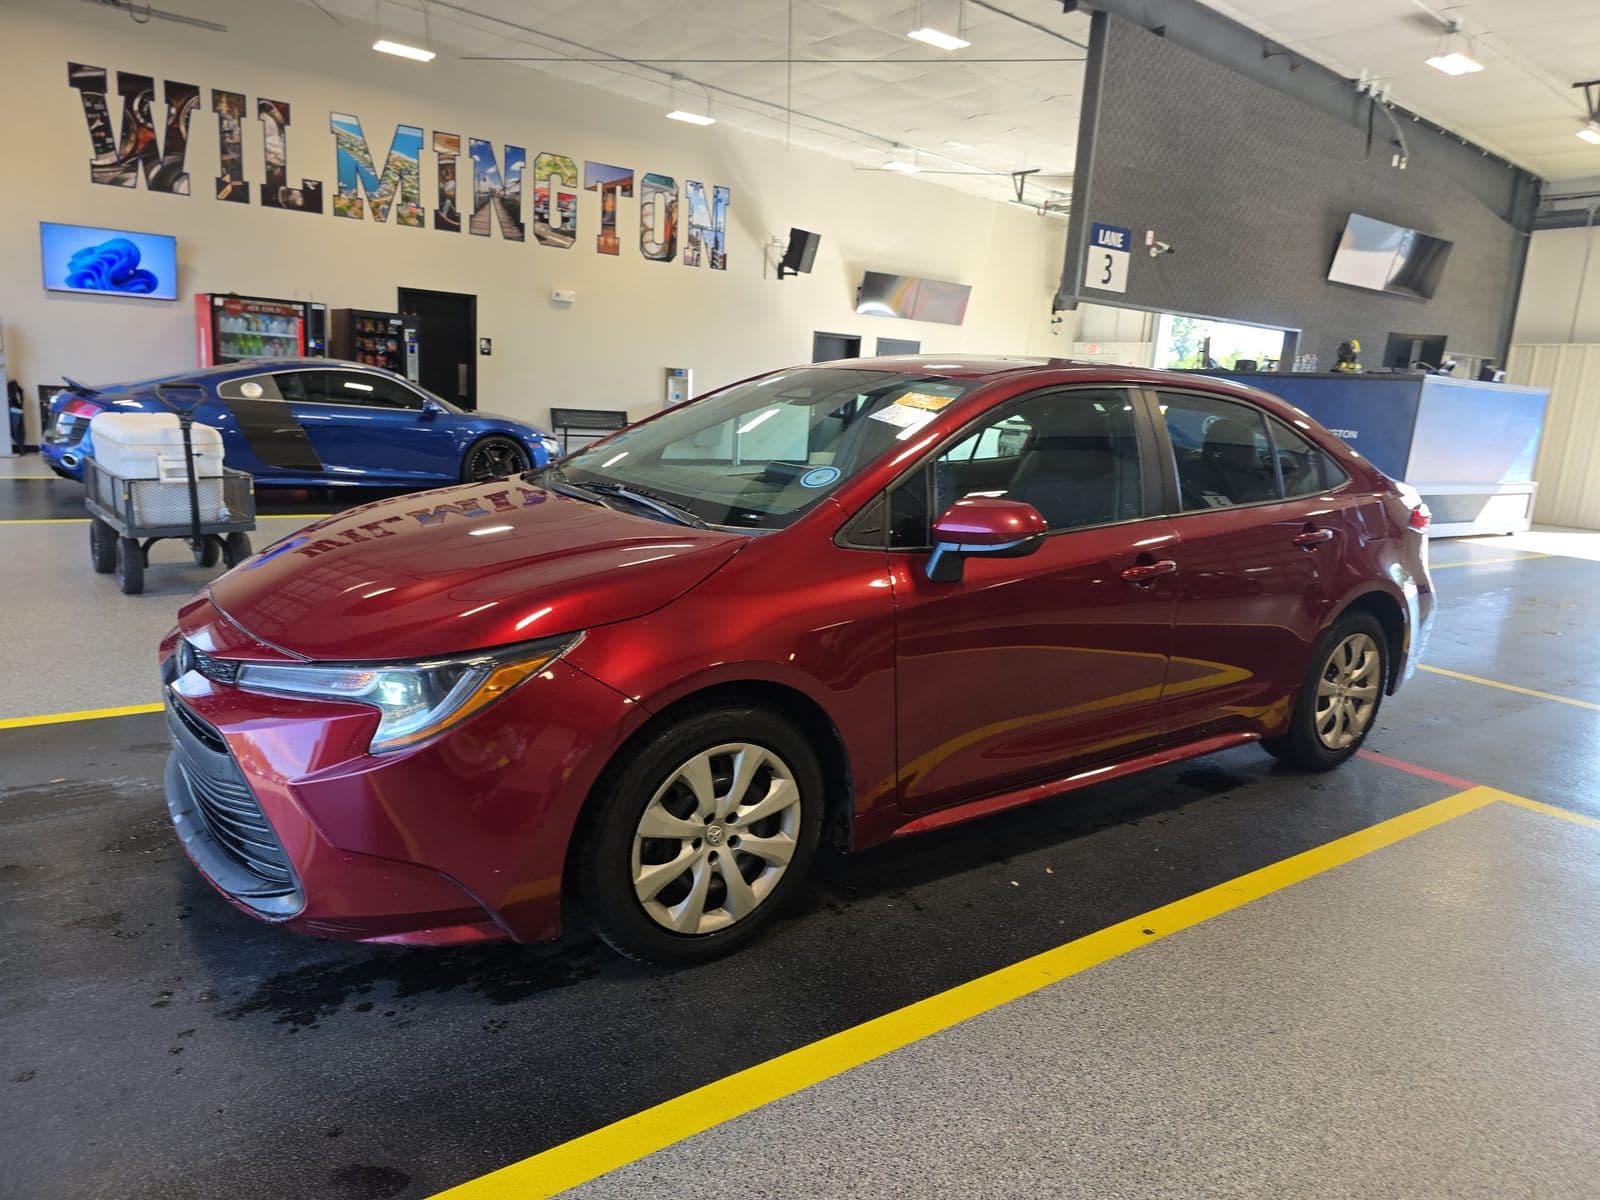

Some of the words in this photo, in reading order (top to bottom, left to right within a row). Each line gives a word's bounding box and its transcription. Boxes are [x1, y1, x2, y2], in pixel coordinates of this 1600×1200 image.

[68, 62, 730, 270] WILMINGTON
[1098, 229, 1124, 248] LANE
[1102, 254, 1112, 284] 3
